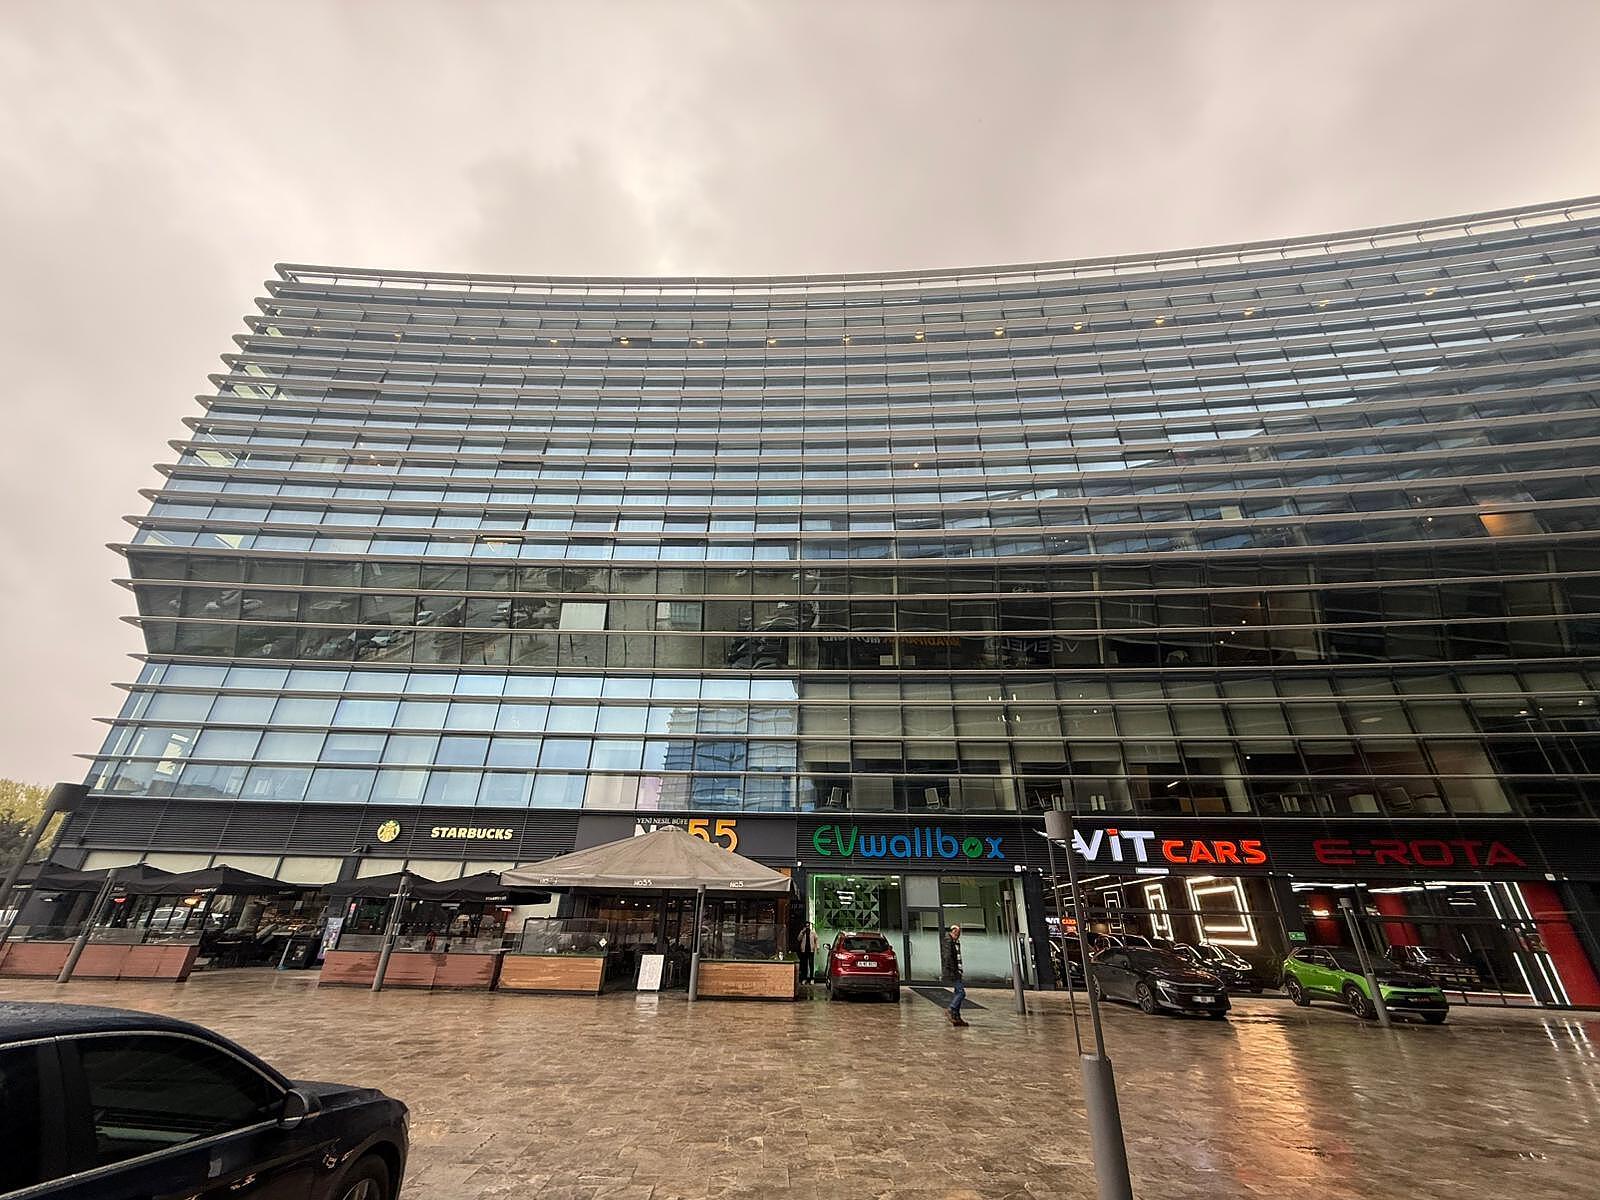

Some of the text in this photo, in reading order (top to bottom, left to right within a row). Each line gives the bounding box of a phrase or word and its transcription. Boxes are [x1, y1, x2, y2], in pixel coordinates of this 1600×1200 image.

[430, 826, 514, 840] STARBUCKS
[813, 825, 1006, 859] EVwallbox
[1162, 839, 1267, 865] CARS
[1312, 838, 1527, 868] E-ROTA
